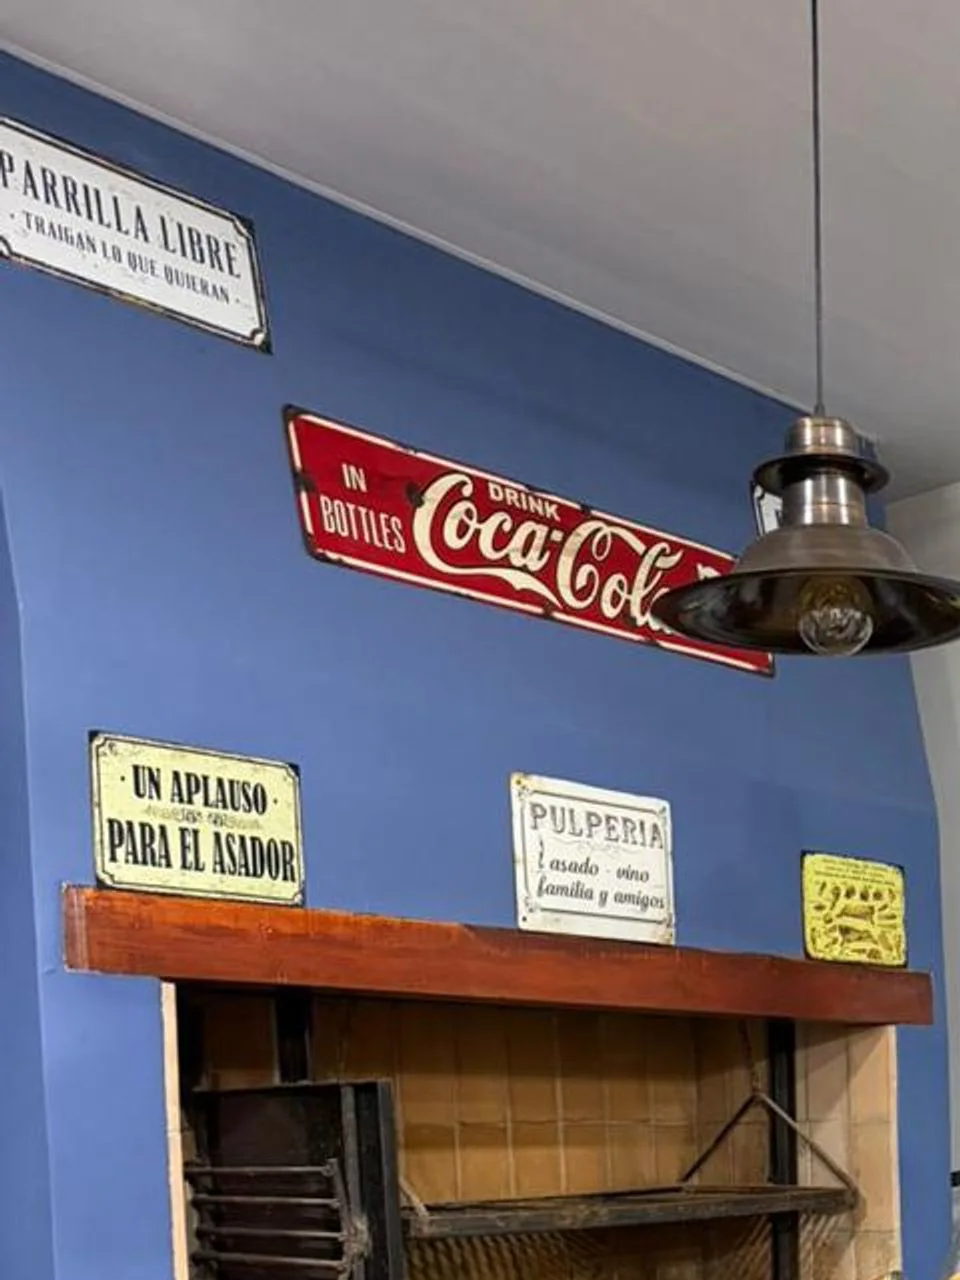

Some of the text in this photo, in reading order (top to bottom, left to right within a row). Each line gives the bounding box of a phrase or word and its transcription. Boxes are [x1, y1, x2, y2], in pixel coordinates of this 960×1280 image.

[0, 150, 241, 278] PARRILLA LIBRE
[22, 210, 230, 304] TRAIGAN LO QUE QUIERAN
[341, 463, 368, 494] IN
[486, 482, 560, 522] DRINK
[320, 495, 406, 554] BOTTLES
[412, 473, 684, 636] Coca-Col
[131, 764, 268, 816] UN APLAUSO
[107, 817, 173, 869] PARA
[178, 826, 205, 872] EL
[211, 830, 296, 883] ASADOR
[529, 802, 664, 850] PULPERIA
[537, 875, 665, 912] familia y amigos
[549, 857, 650, 884] asado vino
